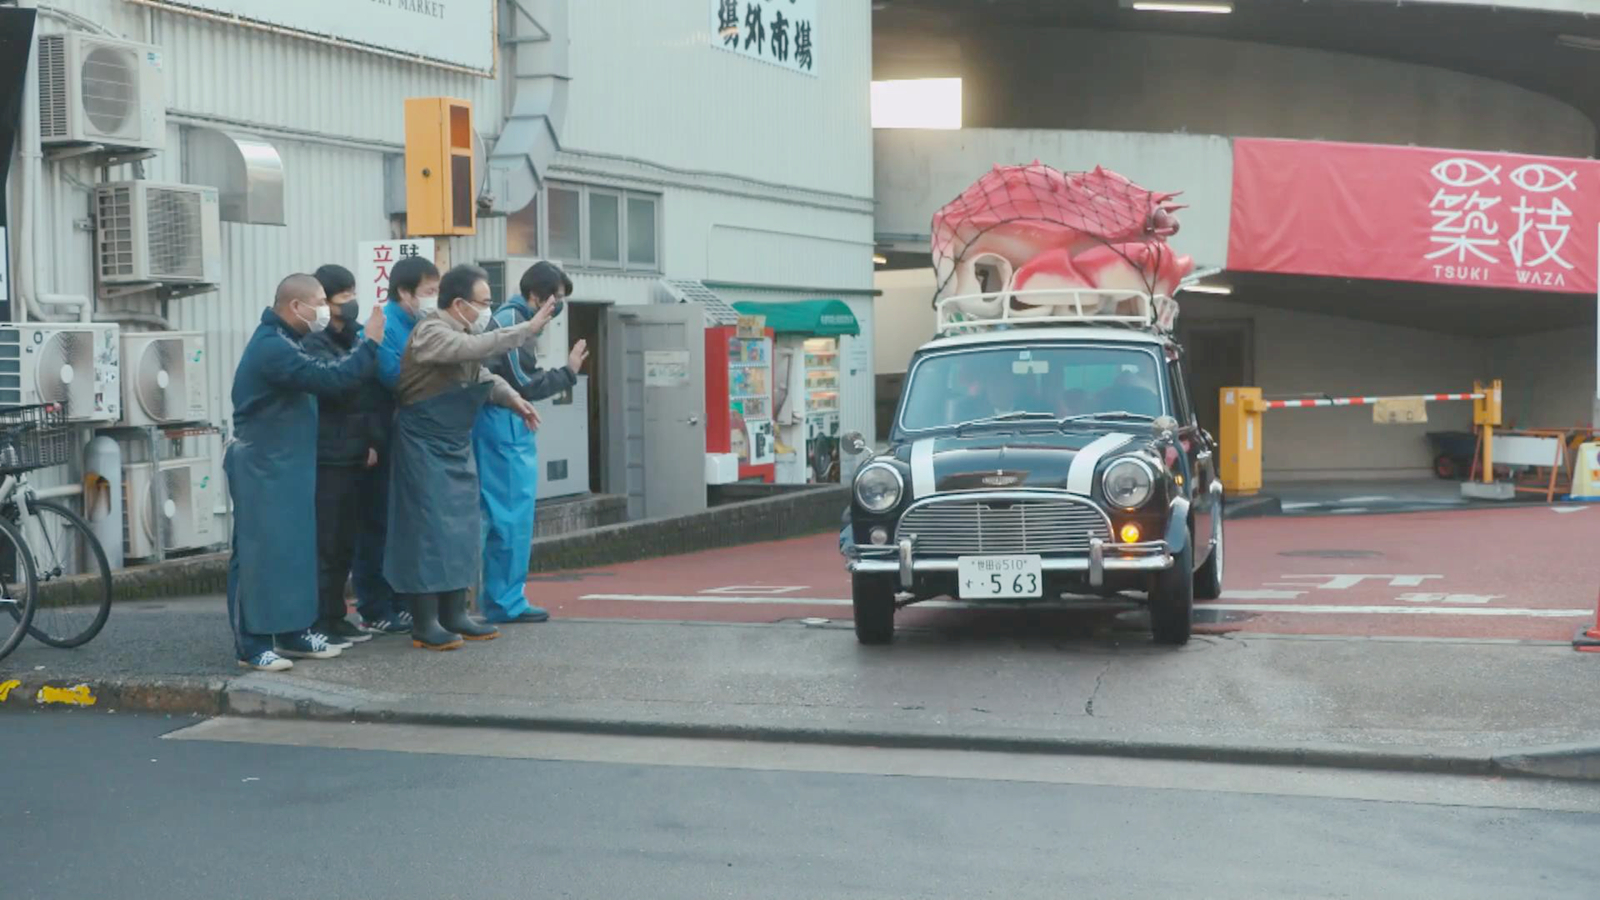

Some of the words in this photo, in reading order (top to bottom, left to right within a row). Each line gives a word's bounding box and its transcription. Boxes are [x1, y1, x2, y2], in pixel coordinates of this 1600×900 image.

[398, 0, 445, 19] MARKET
[718, 0, 812, 71] 場外市場
[1433, 265, 1488, 280] TSUKI
[1516, 270, 1565, 287] WAZA
